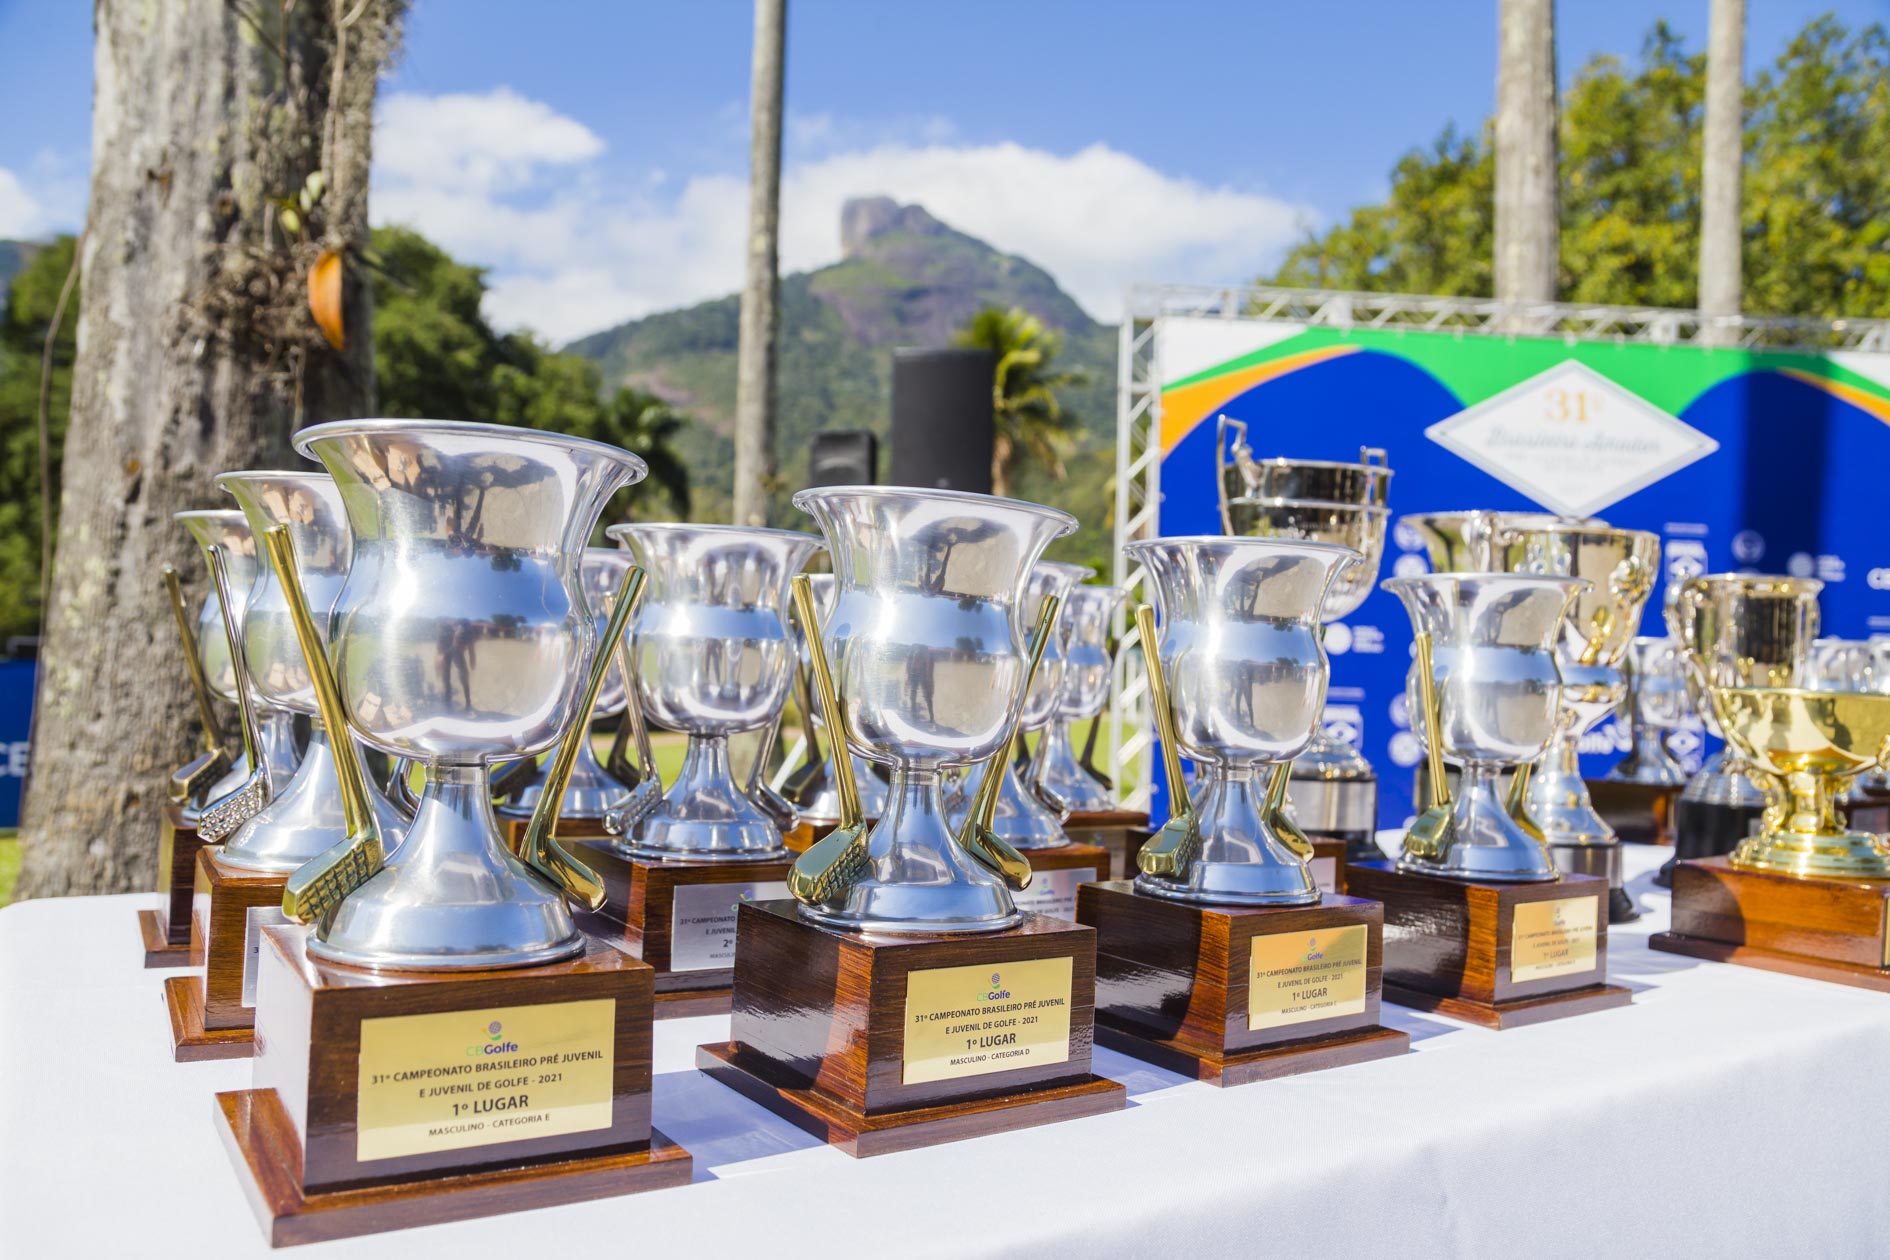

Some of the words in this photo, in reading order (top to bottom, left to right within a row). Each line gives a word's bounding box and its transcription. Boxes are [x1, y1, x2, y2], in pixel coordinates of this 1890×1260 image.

[692, 916, 736, 924] CAMPEONATO
[723, 939, 733, 948] 2º
[1266, 966, 1302, 978] CAMPEONATO
[1303, 961, 1331, 972] BRASILEIRO
[1282, 979, 1303, 988] JUVENIL
[1303, 977, 1311, 985] DE
[1311, 974, 1328, 984] GOLFE
[1292, 992, 1300, 1001] 1º
[1302, 987, 1328, 1000] LUGAR
[929, 1007, 980, 1021] CAMPEONATO
[982, 1003, 1022, 1015] BRASILEIRO
[1024, 999, 1036, 1009] PRÉ
[1038, 997, 1065, 1008] JUVENIL
[945, 1026, 950, 1034] E
[951, 1023, 981, 1034] JUVENIL
[983, 1021, 992, 1030] DE
[994, 1018, 1017, 1028] GOLFE
[1022, 1015, 1038, 1025] 2021
[465, 1041, 518, 1057] CBGolfe
[966, 1038, 977, 1050] 1º
[980, 1033, 1016, 1048] LUGAR
[393, 1064, 472, 1082] CAMPEONATO
[475, 1057, 537, 1073] BRASILEIRO
[540, 1053, 559, 1066] PRÉ
[561, 1050, 603, 1063] JUVENIL
[950, 1054, 987, 1066] MASCULINO
[991, 1049, 1024, 1060] CATEGORIA
[419, 1088, 425, 1098] E
[428, 1083, 474, 1097] JUVENIL
[477, 1080, 492, 1091] DE
[494, 1076, 529, 1089] GOLFE
[538, 1073, 562, 1084] 2021
[452, 1103, 468, 1117] 1º
[473, 1094, 529, 1114] LUGAR
[428, 1122, 484, 1136] MASCULINO
[492, 1114, 542, 1128] CATEGORIA
[545, 1113, 550, 1121] E
